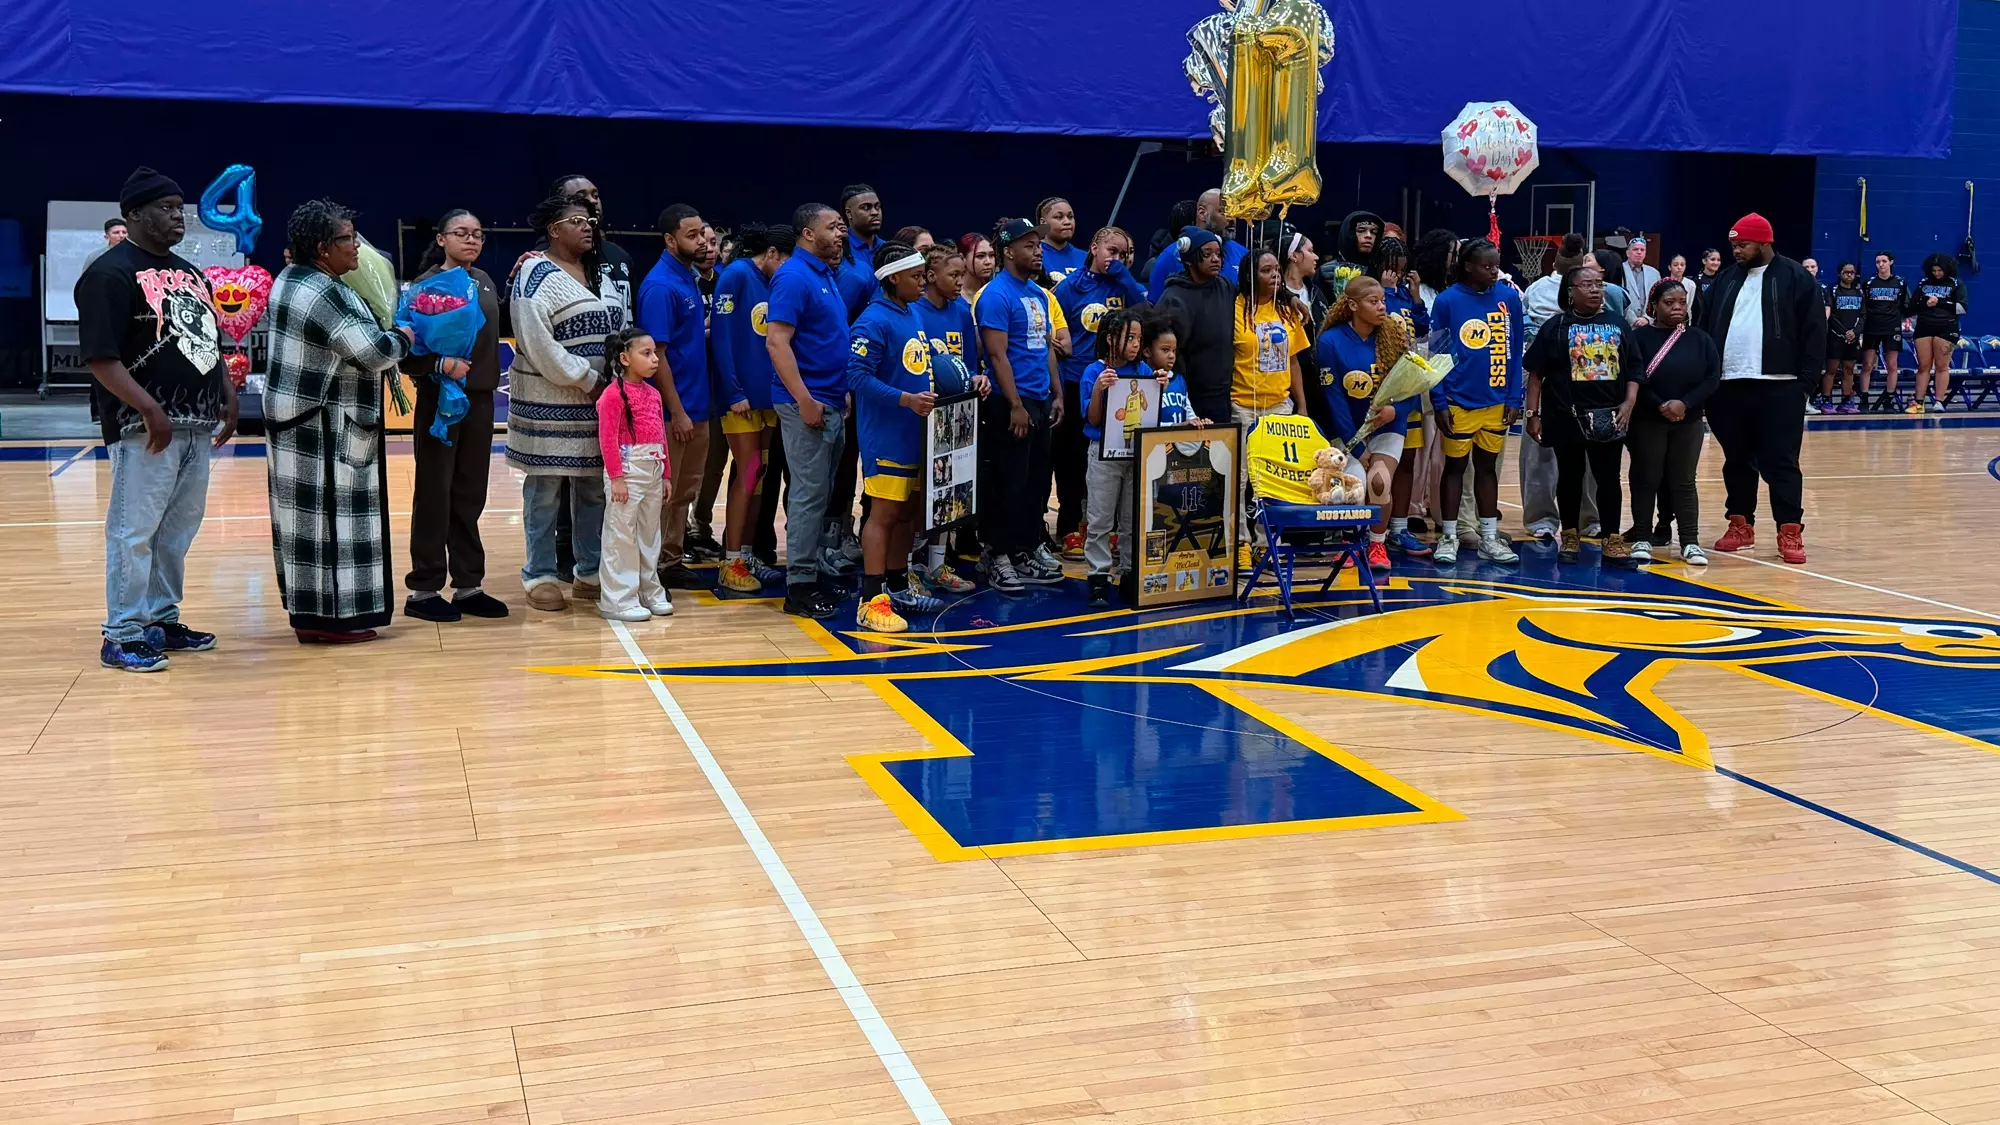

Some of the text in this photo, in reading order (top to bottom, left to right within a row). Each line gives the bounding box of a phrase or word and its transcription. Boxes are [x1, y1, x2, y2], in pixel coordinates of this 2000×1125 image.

[1480, 117, 1515, 137] Happy
[199, 163, 263, 256] 4
[1470, 329, 1486, 339] M
[913, 350, 923, 363] M
[1486, 311, 1507, 387] EXPRESS
[1351, 380, 1368, 391] M
[1265, 421, 1311, 439] MONROE
[1281, 440, 1300, 464] 11
[1265, 460, 1318, 482] EXPRES
[1316, 508, 1373, 521] MUSTANGS
